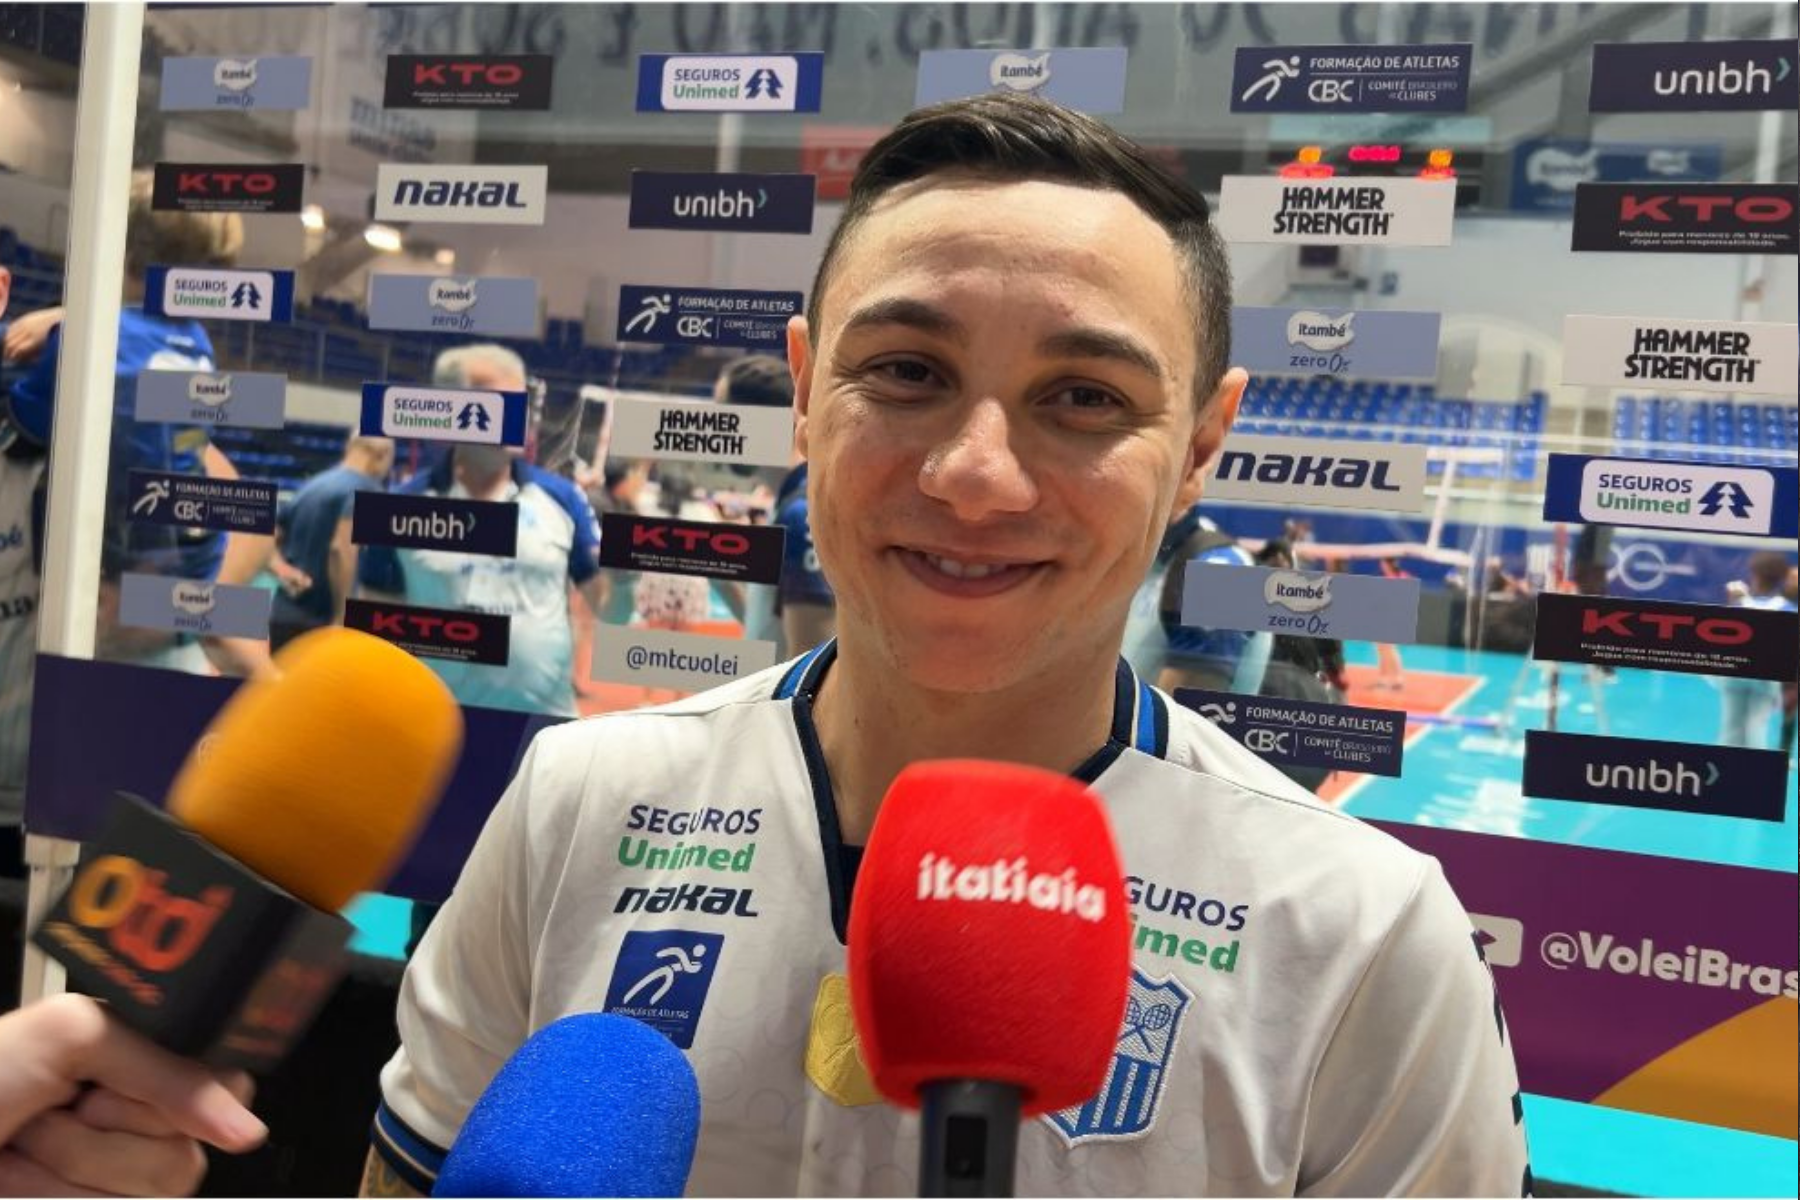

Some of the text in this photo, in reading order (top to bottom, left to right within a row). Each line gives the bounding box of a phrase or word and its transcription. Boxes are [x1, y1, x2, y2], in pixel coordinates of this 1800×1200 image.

[414, 62, 523, 85] KTO
[674, 68, 740, 81] SEGUROS
[1310, 56, 1460, 71] FORMAÇÃO DE ATLETAS
[1654, 60, 1771, 95] unibh
[673, 84, 739, 99] Unimed
[1308, 80, 1354, 102] CBC
[179, 173, 277, 195] KTO
[673, 189, 754, 218] unibh
[1282, 187, 1385, 212] HAMMER
[1620, 196, 1793, 222] KTO
[1273, 211, 1389, 236] STRENGTH
[175, 279, 228, 292] SEGUROS
[173, 293, 226, 307] Unimed
[736, 299, 750, 310] DE
[751, 300, 794, 312] ATLETAS
[677, 316, 713, 337] CBC
[1298, 323, 1346, 337] itambé
[1634, 328, 1751, 356] HAMMER
[1290, 355, 1327, 368] zero
[1625, 355, 1755, 383] STRENGTH
[394, 398, 454, 413] SEGUROS
[393, 412, 452, 429] Unimed
[660, 409, 740, 434] HAMMER
[653, 431, 743, 455] STRENGTH
[1599, 474, 1693, 493] SEGUROS
[1597, 492, 1691, 514] Unimed
[391, 511, 465, 541] unibh
[632, 524, 750, 555] KTO
[1276, 584, 1324, 600] itambé
[372, 611, 480, 641] KTO
[1269, 615, 1305, 629] zero
[1582, 609, 1753, 644] KTO
[1246, 707, 1393, 732] FORMAÇÃO DE ATLETAS
[1244, 728, 1289, 754] CBC
[1586, 759, 1701, 797] unibh
[627, 804, 763, 835] SEGUROS
[618, 836, 756, 873] Unimed
[918, 852, 1106, 921] itatiaia
[1124, 876, 1249, 931] GUROS
